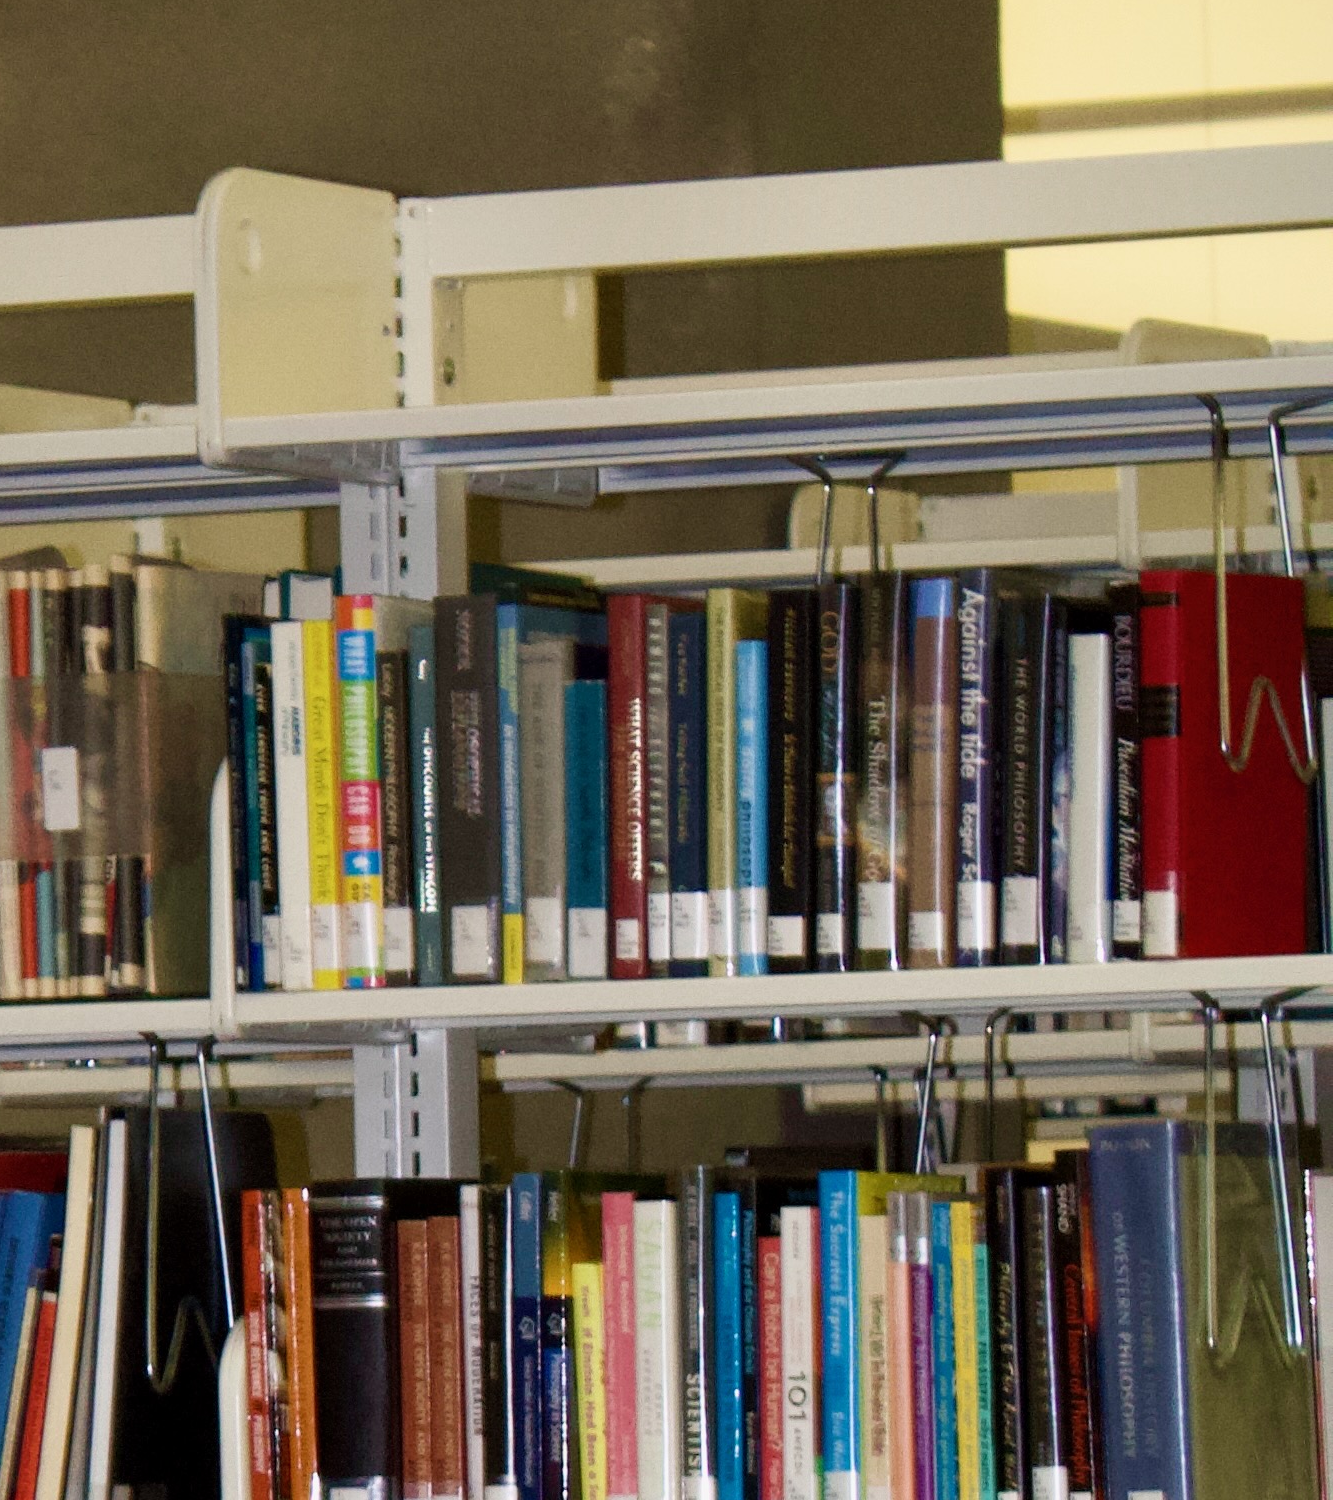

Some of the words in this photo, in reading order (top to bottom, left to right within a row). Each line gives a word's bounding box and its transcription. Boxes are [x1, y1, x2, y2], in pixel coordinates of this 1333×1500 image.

[342, 636, 367, 675] WHAT
[955, 588, 983, 683] Against
[1115, 615, 1132, 710] BOURDIEU
[1014, 658, 1027, 688] THE
[342, 685, 368, 777] PHILOSOPHY
[626, 698, 641, 746] WHAT
[868, 696, 889, 726] The
[961, 689, 980, 721] the
[1014, 693, 1027, 754] WORLD
[962, 727, 981, 778] tide
[346, 786, 369, 819] CAN
[627, 751, 641, 817] SCIENCE
[347, 825, 371, 845] DO
[960, 802, 979, 861] Roger
[1014, 761, 1027, 866] PHILOSOPHY
[627, 823, 642, 880] OFFERS
[1118, 823, 1139, 901] Meditatio
[829, 1191, 842, 1218] The
[764, 1253, 779, 1282] Can
[828, 1224, 843, 1292] Socrates
[1113, 1235, 1130, 1326] WESTERN
[764, 1303, 779, 1350] Robot
[827, 1296, 844, 1356] Express
[765, 1354, 780, 1376] be
[1119, 1332, 1136, 1458] PHILOSOPHY
